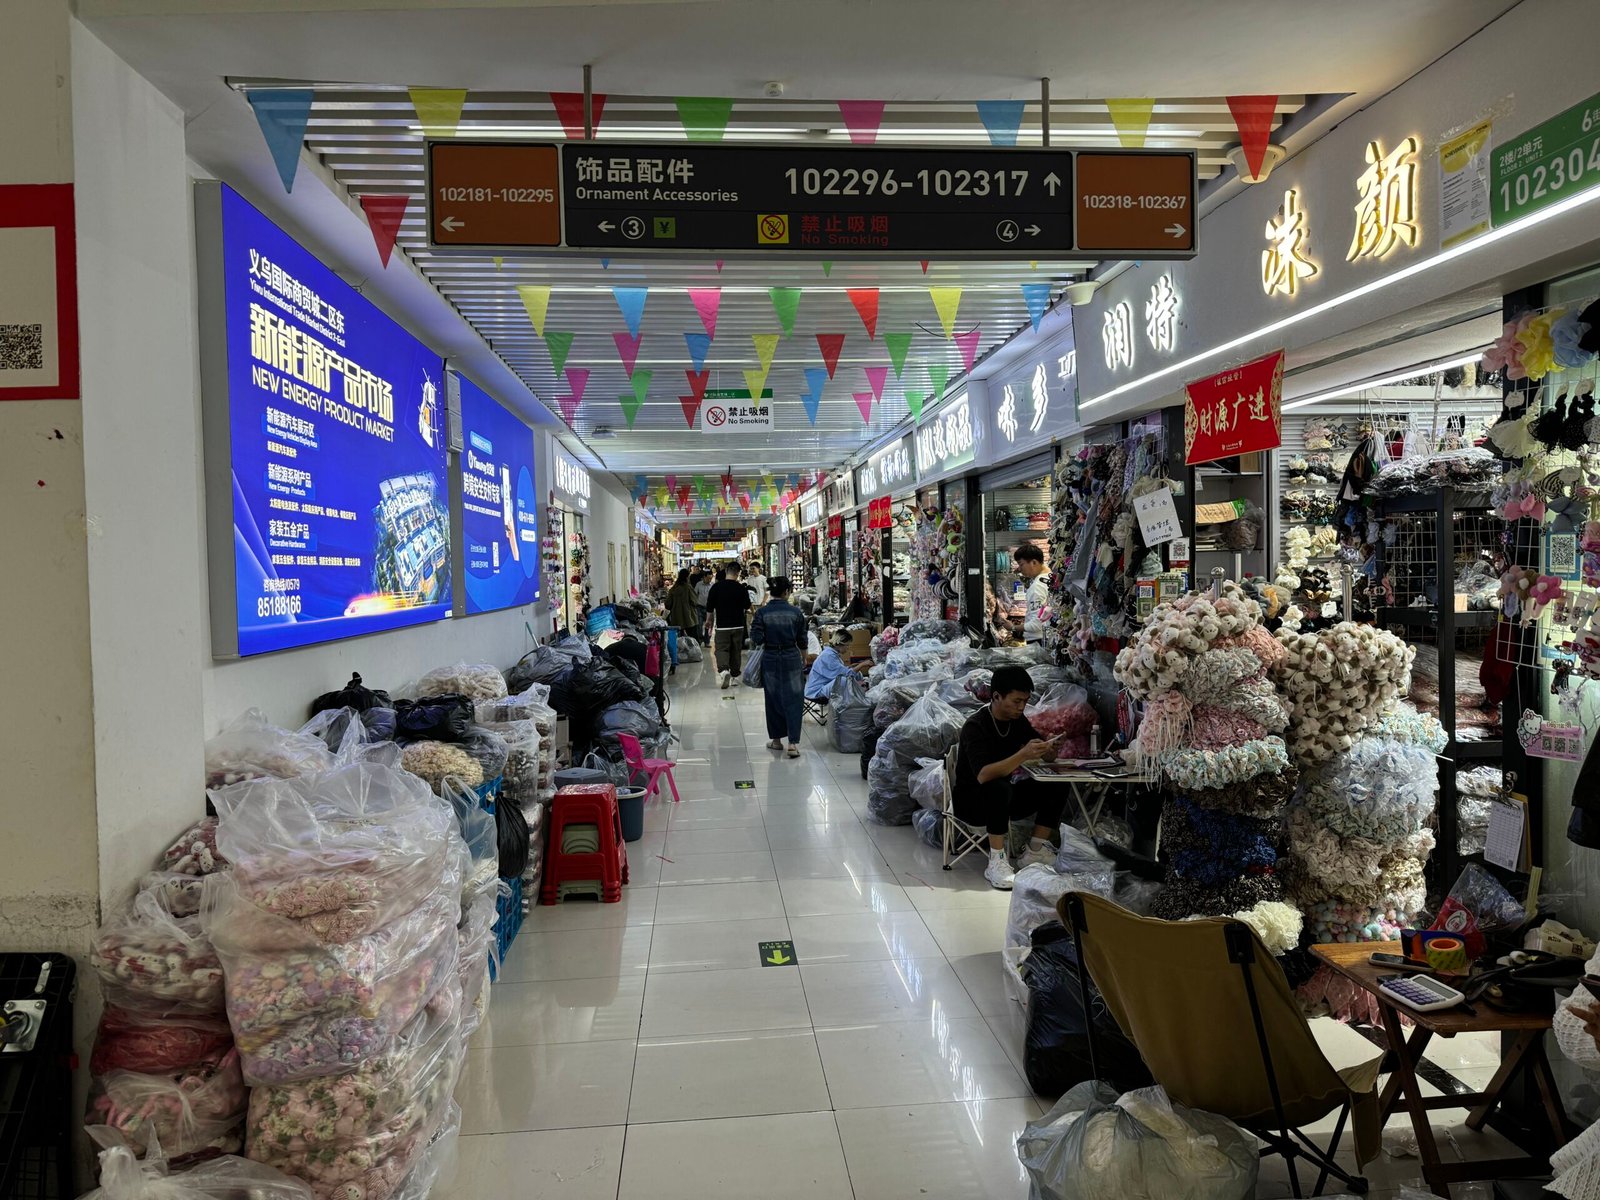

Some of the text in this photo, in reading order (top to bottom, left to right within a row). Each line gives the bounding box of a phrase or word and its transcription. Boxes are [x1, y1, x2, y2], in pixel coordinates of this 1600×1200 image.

[1500, 136, 1543, 167] 2楼/2单元
[1500, 162, 1518, 176] FLOOR
[1525, 152, 1539, 163] UNIT
[575, 157, 694, 184] 饰品配件
[785, 168, 1029, 196] 102296-102317
[439, 187, 554, 203] 102181-102295
[576, 187, 738, 203] Ornament Accessories
[1083, 195, 1187, 210] 102318-102367
[801, 215, 889, 233] 禁止吸烟
[801, 234, 889, 246] No Smoking
[249, 248, 345, 334] 义乌国际商贸城二区东
[250, 277, 263, 295] Yiwu
[264, 286, 292, 314] International
[293, 304, 306, 322] Trade
[306, 313, 320, 332] Market
[250, 302, 394, 423] 新能源产品市场
[252, 364, 394, 443] NEW ENERGY PRODUCT MARKET
[728, 406, 769, 417] 禁止吸烟
[1200, 385, 1269, 437] 财源广进
[266, 406, 315, 439] 新能源汽车展示区
[268, 462, 312, 488] 新能源系列产品
[268, 482, 306, 497] New Energy Products
[269, 519, 310, 540] 家装五金产品
[257, 595, 302, 618] 85188166
